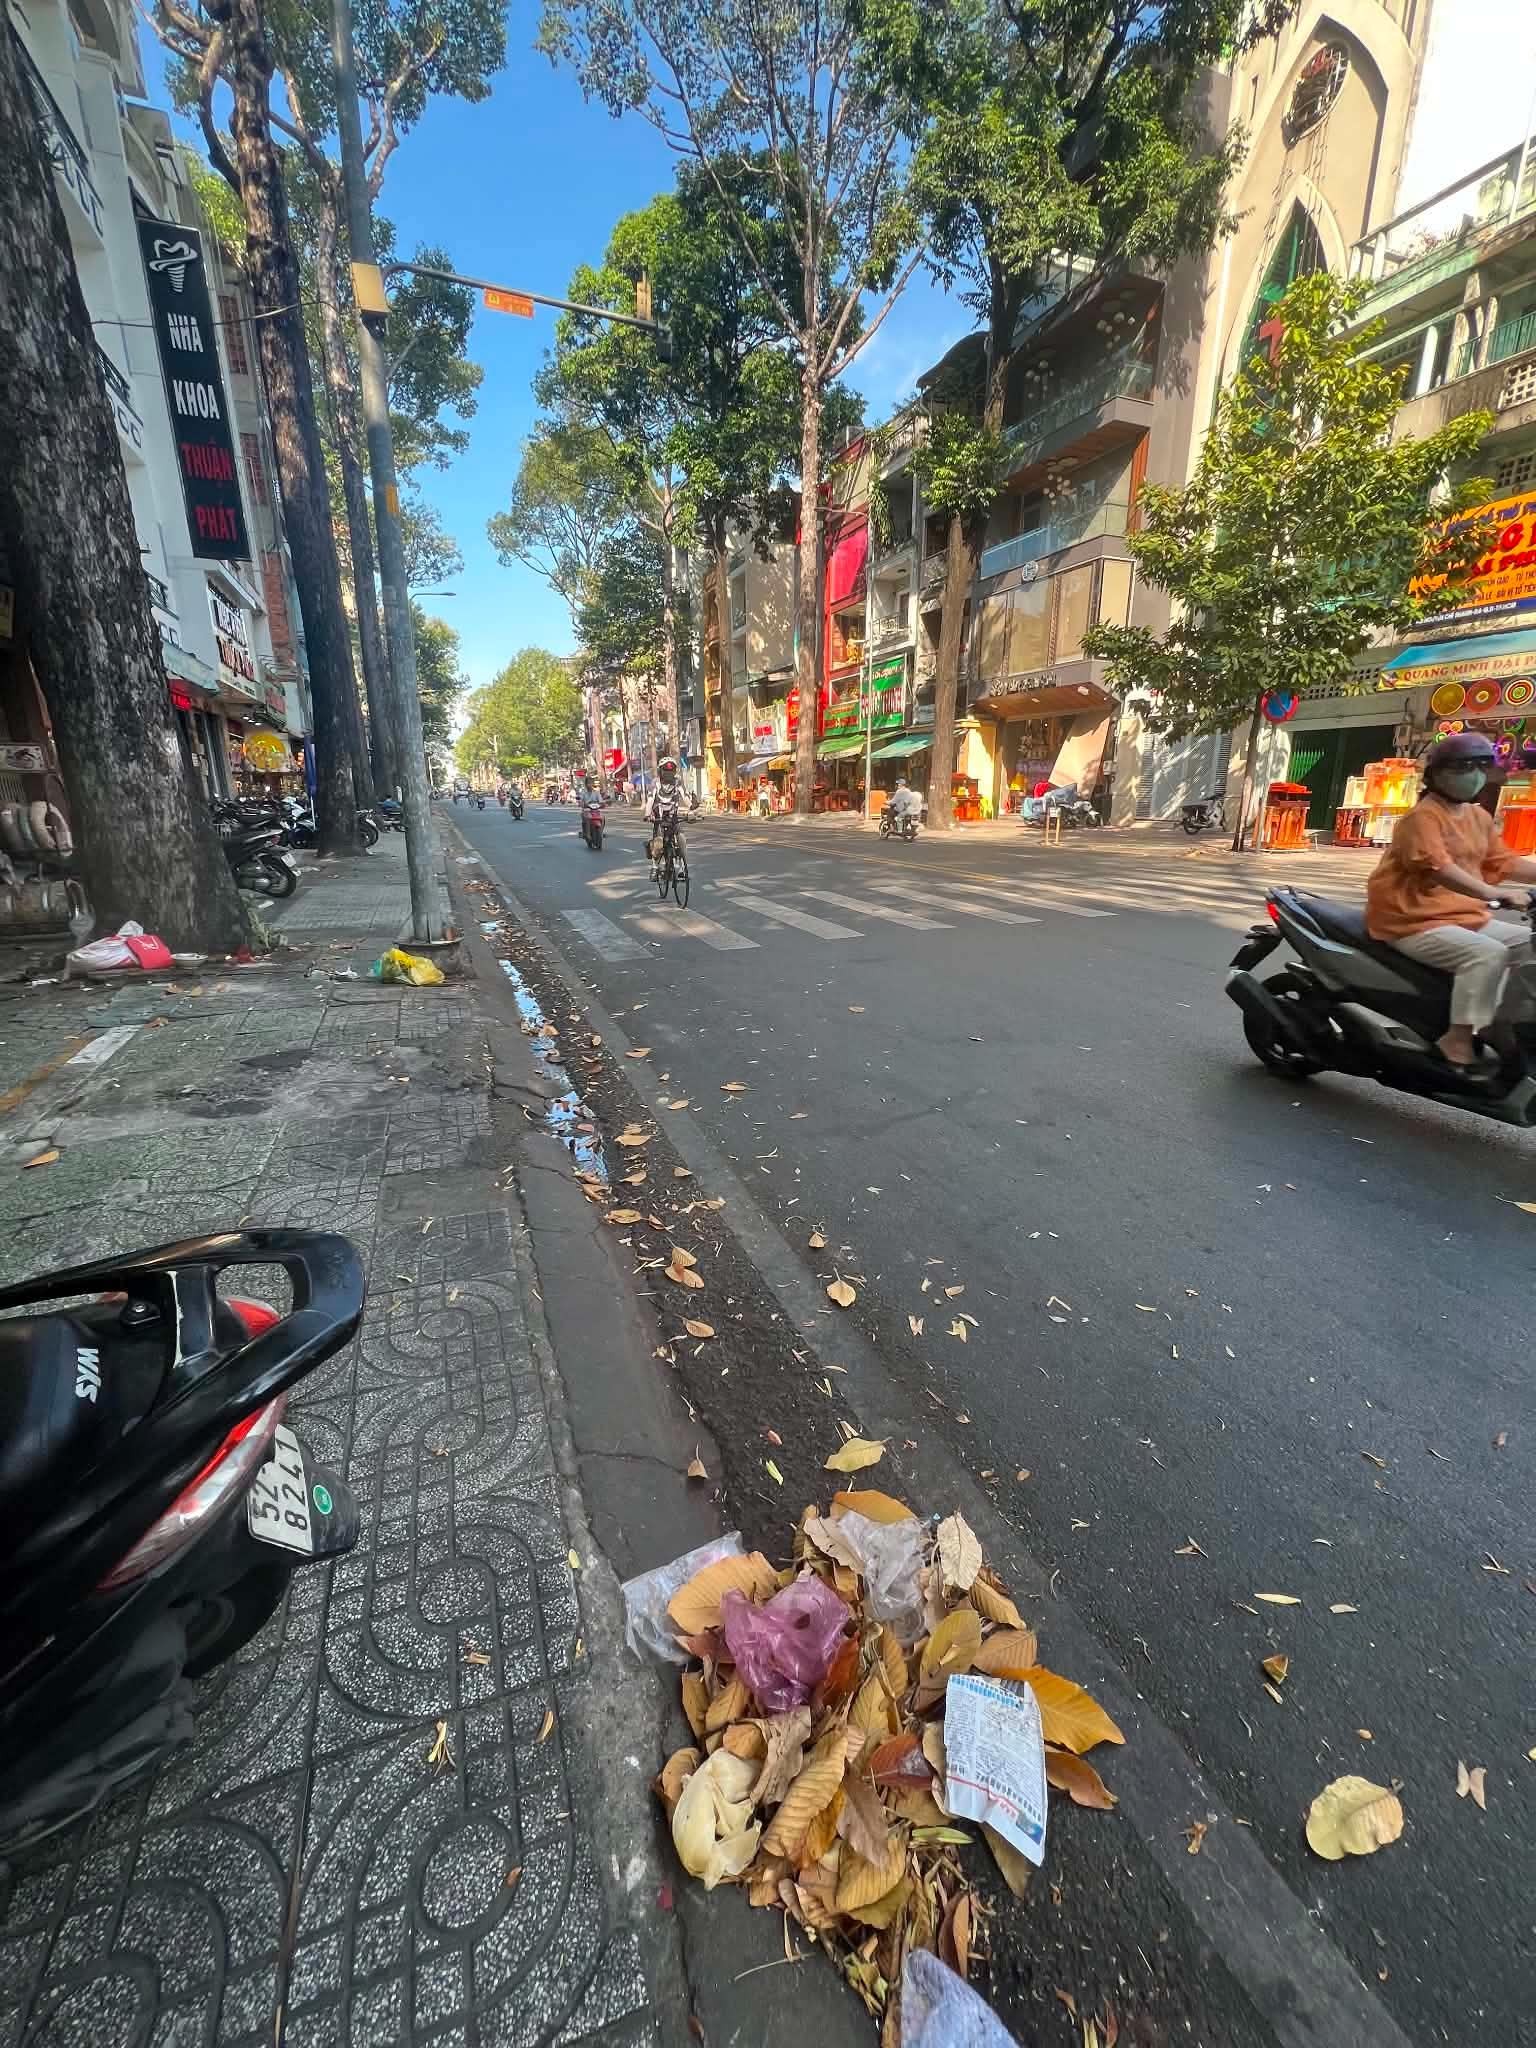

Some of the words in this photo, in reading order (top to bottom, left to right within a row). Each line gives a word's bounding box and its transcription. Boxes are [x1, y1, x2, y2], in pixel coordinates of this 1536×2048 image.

[167, 312, 204, 353] NHA
[173, 379, 220, 420] KHOA
[1403, 667, 1449, 681] QUANG
[1453, 661, 1489, 675] MINH
[75, 1348, 101, 1403] SYM
[275, 1438, 308, 1531] 8241
